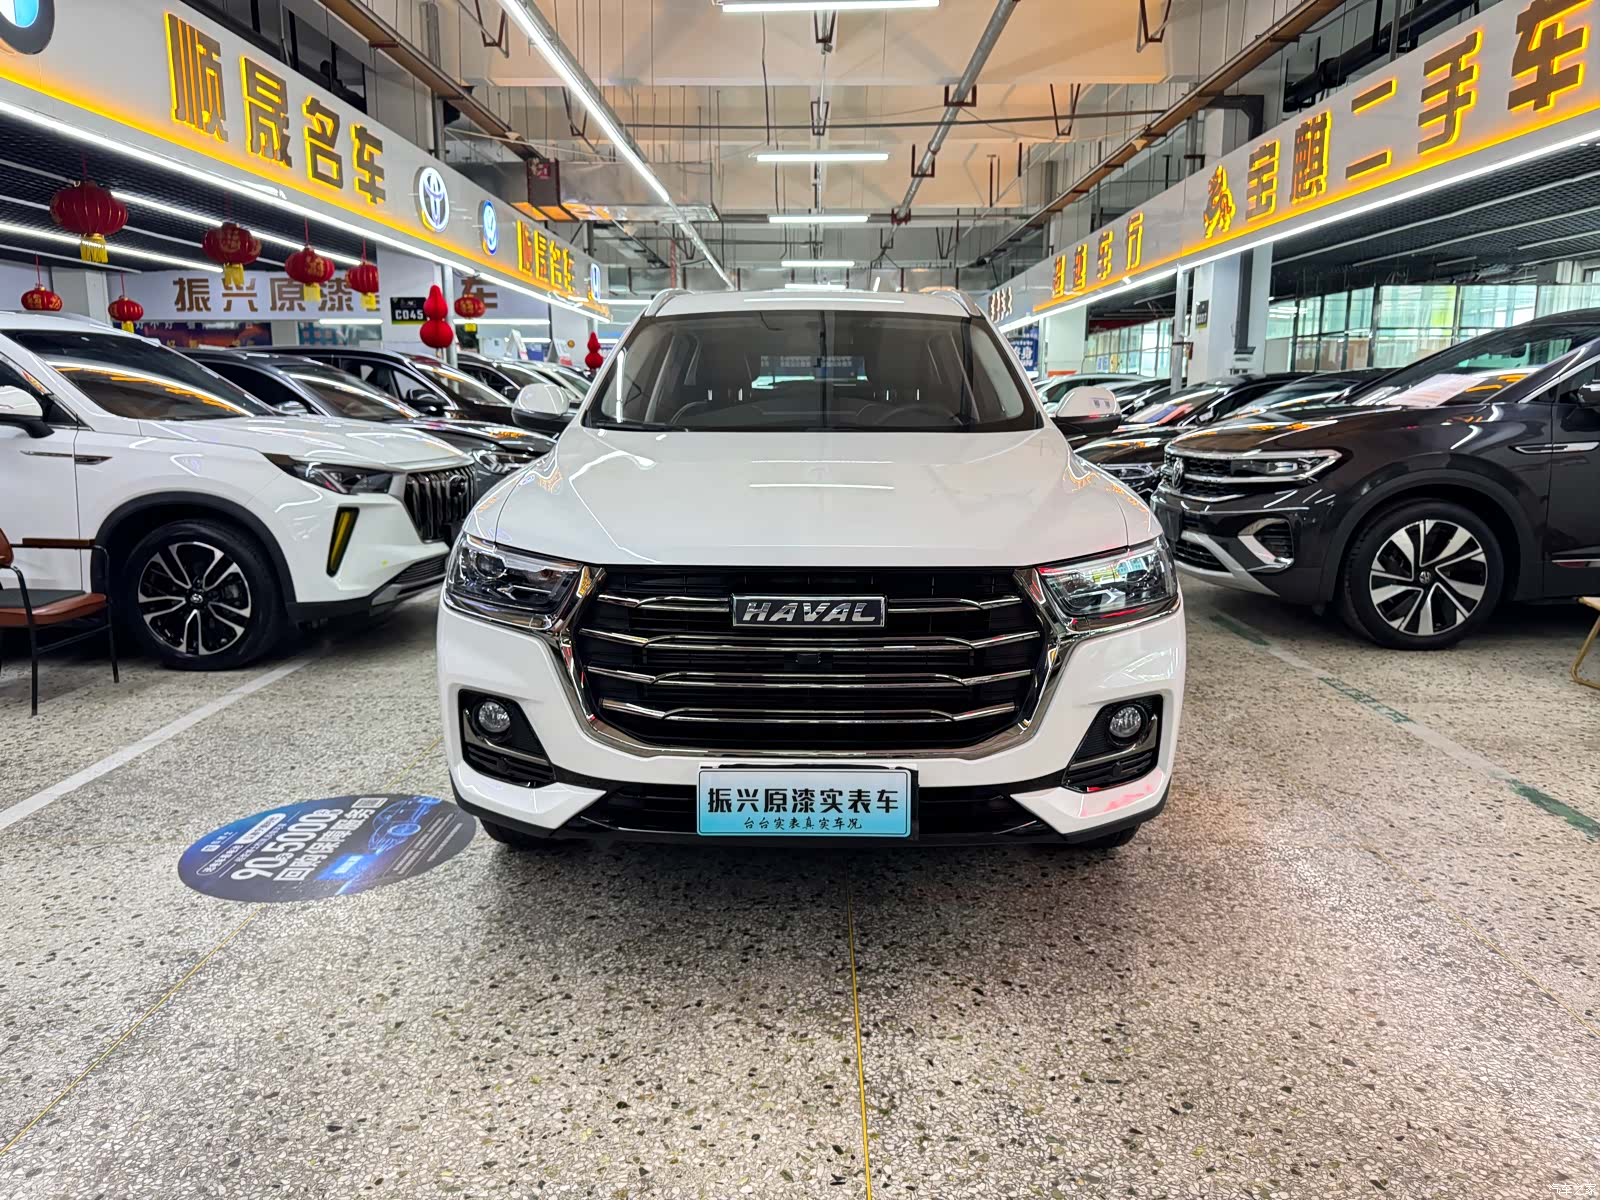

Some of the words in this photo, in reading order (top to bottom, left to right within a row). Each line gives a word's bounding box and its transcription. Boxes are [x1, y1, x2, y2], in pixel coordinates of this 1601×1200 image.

[164, 11, 386, 205] 顺晟名车
[1245, 0, 1593, 222] 宝麒二手车
[742, 602, 875, 622] HAVAL
[707, 787, 899, 814] 振兴原漆实表车
[743, 816, 862, 831] 台台实表真实车况
